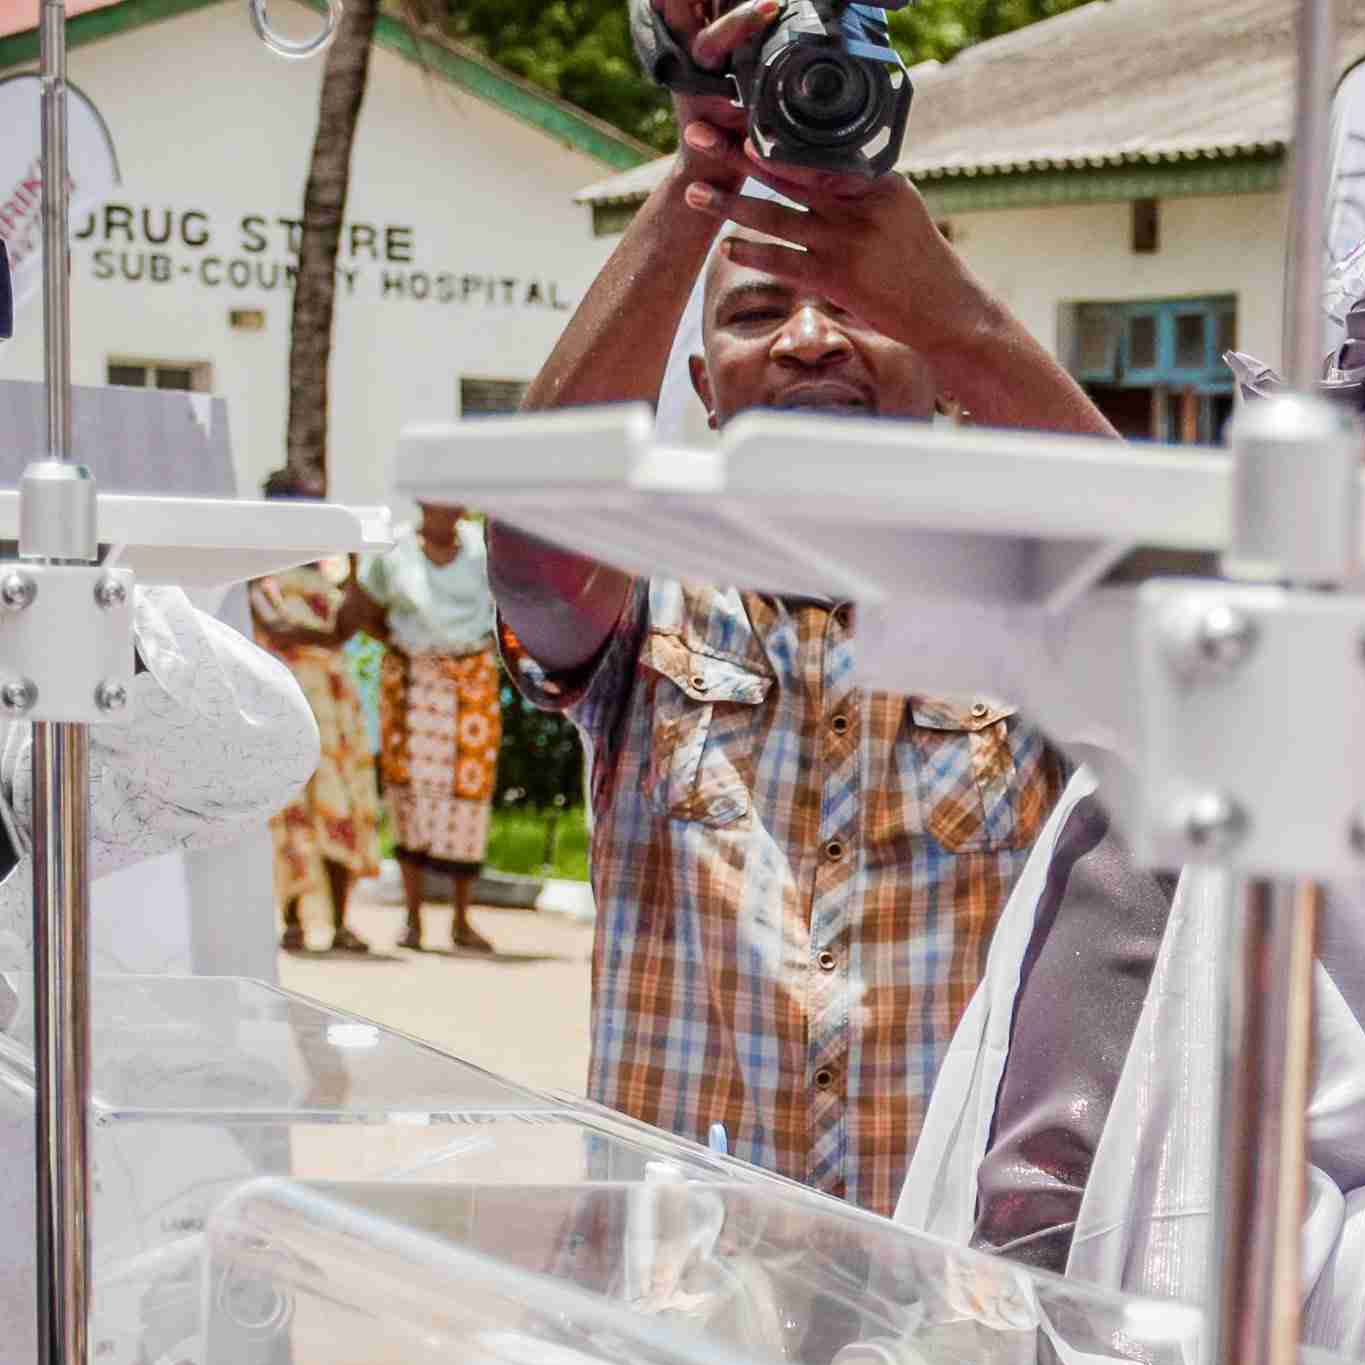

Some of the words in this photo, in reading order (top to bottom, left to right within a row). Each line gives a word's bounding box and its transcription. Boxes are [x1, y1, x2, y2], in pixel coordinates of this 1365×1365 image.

[240, 214, 414, 262] STRE
[93, 250, 358, 293] SUB-COUY
[381, 270, 569, 310] HOSPITAL
